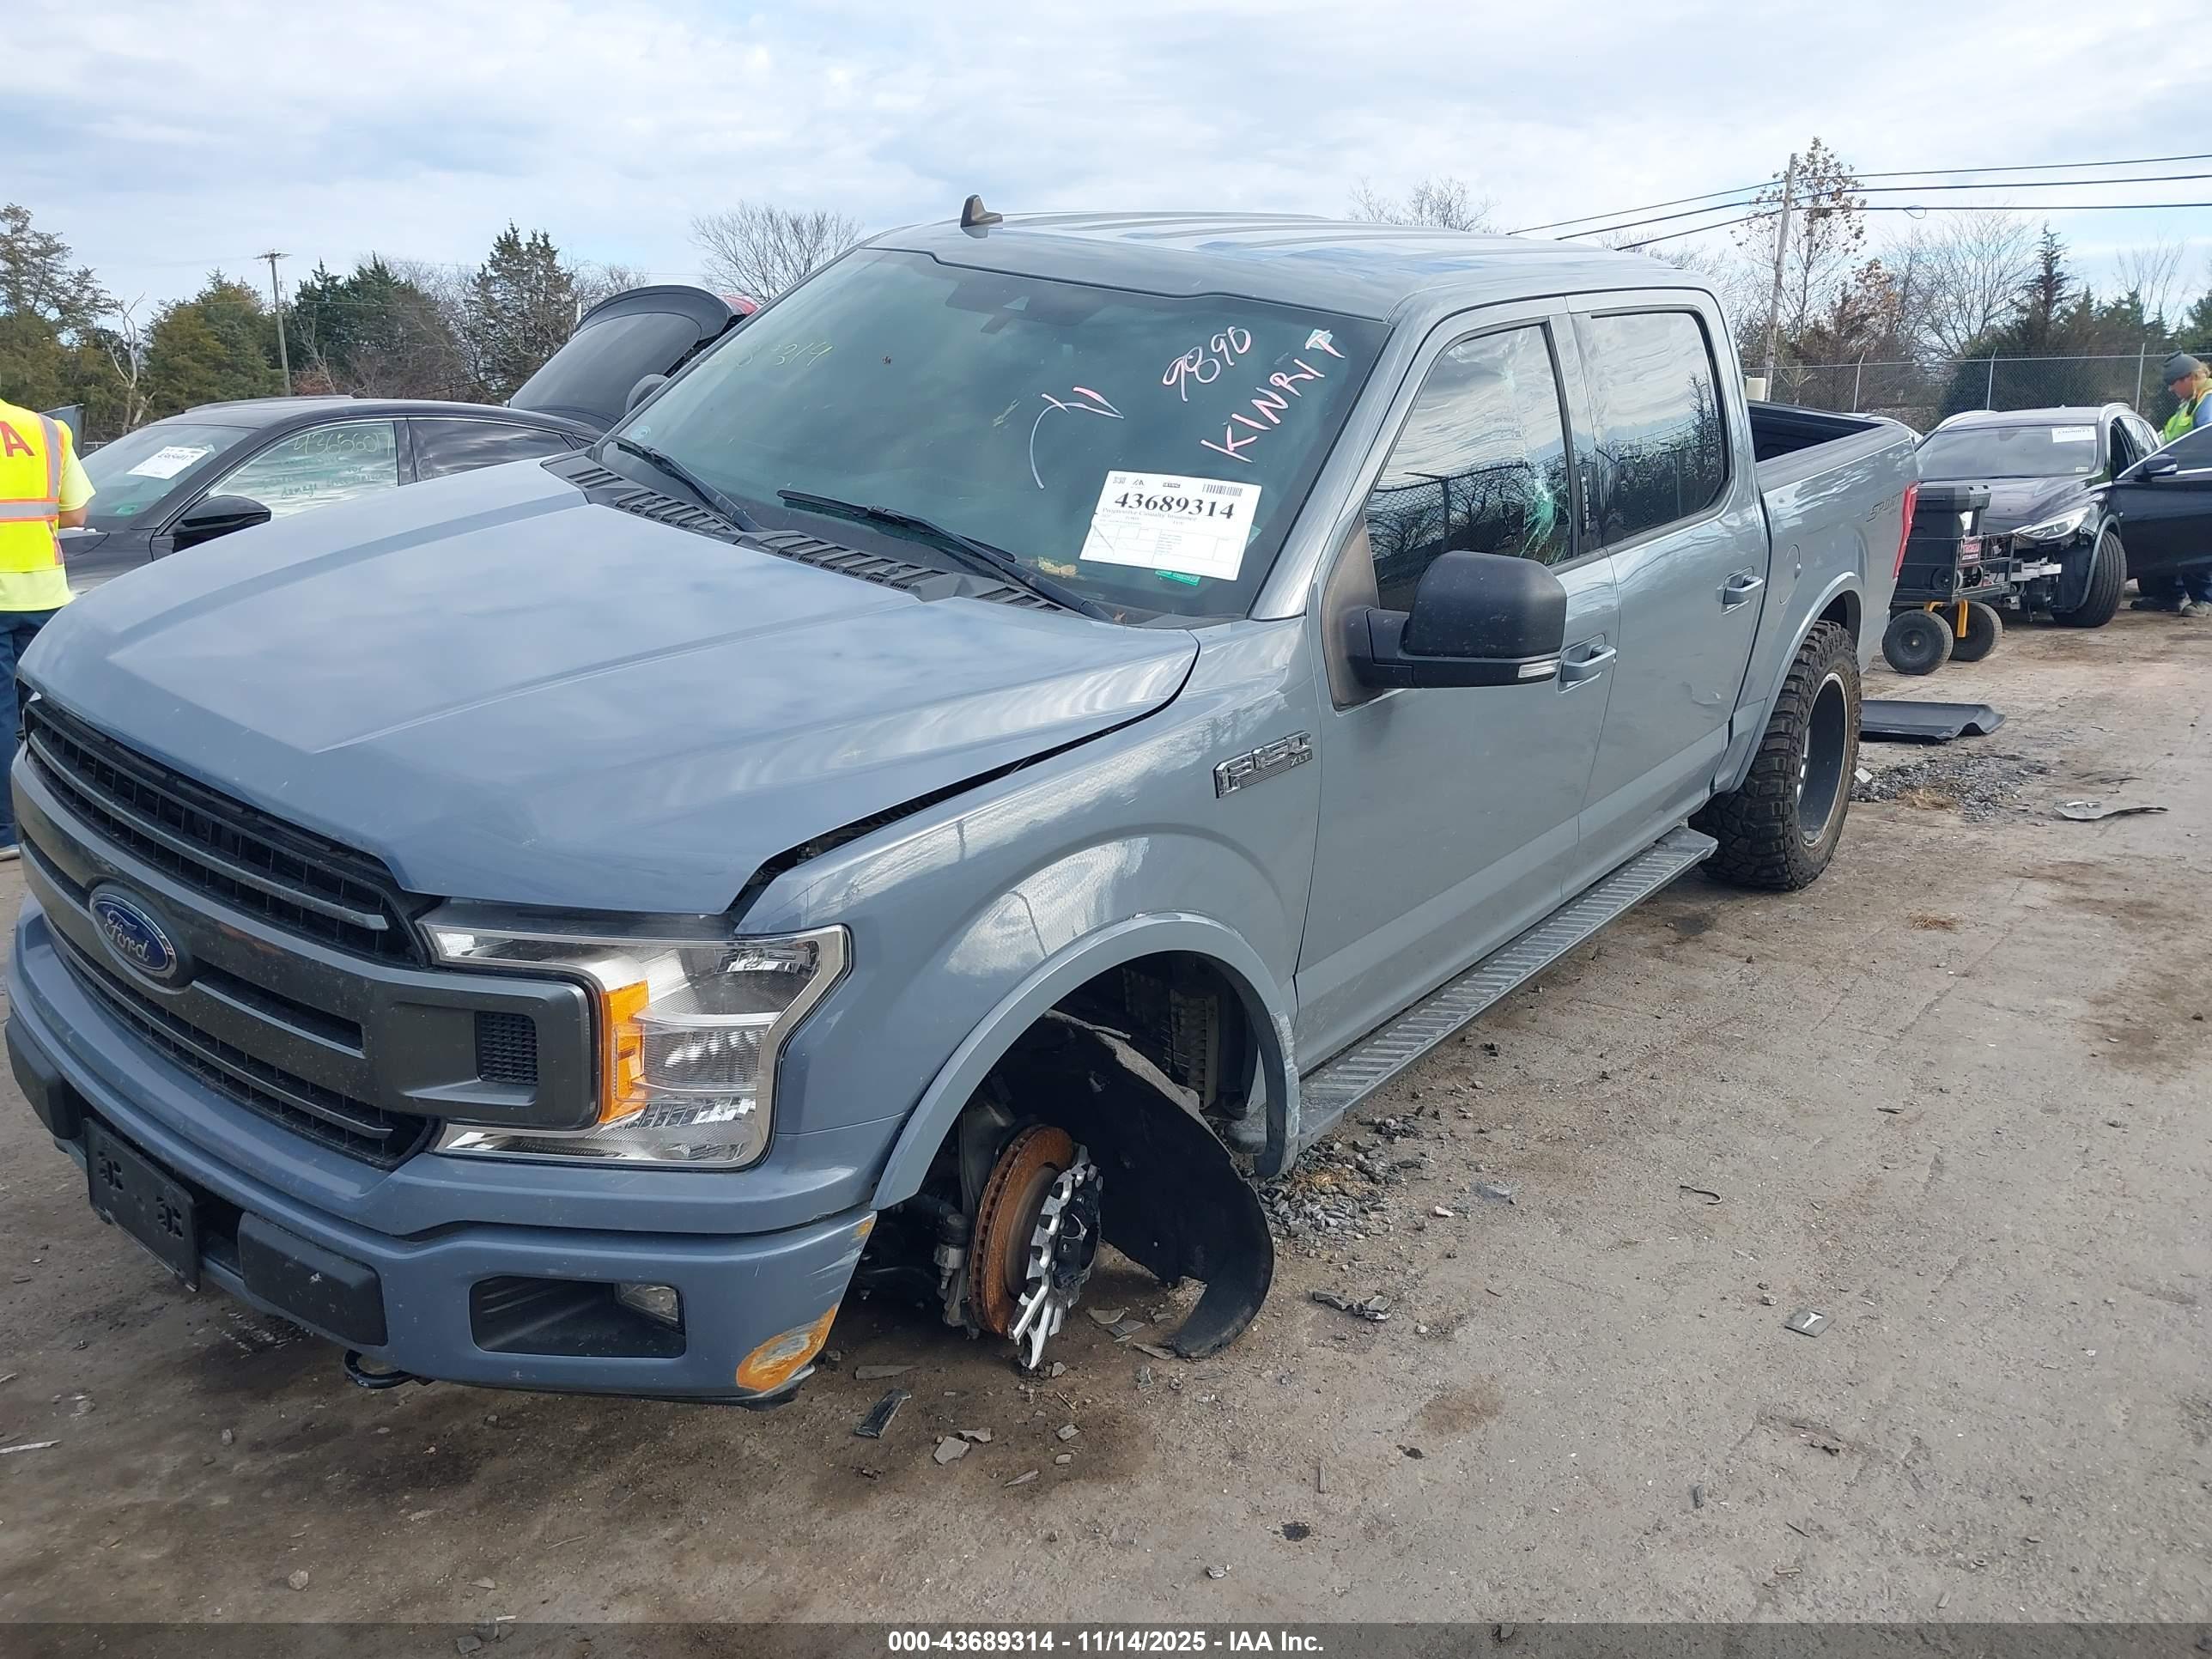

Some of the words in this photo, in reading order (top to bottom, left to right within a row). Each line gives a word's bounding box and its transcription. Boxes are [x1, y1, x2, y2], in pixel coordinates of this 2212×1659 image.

[1162, 325, 1252, 403] 9890
[0, 420, 36, 458] A
[1115, 492, 1235, 520] 43689314
[1291, 751, 1311, 767] XLT
[104, 909, 150, 962] Ford
